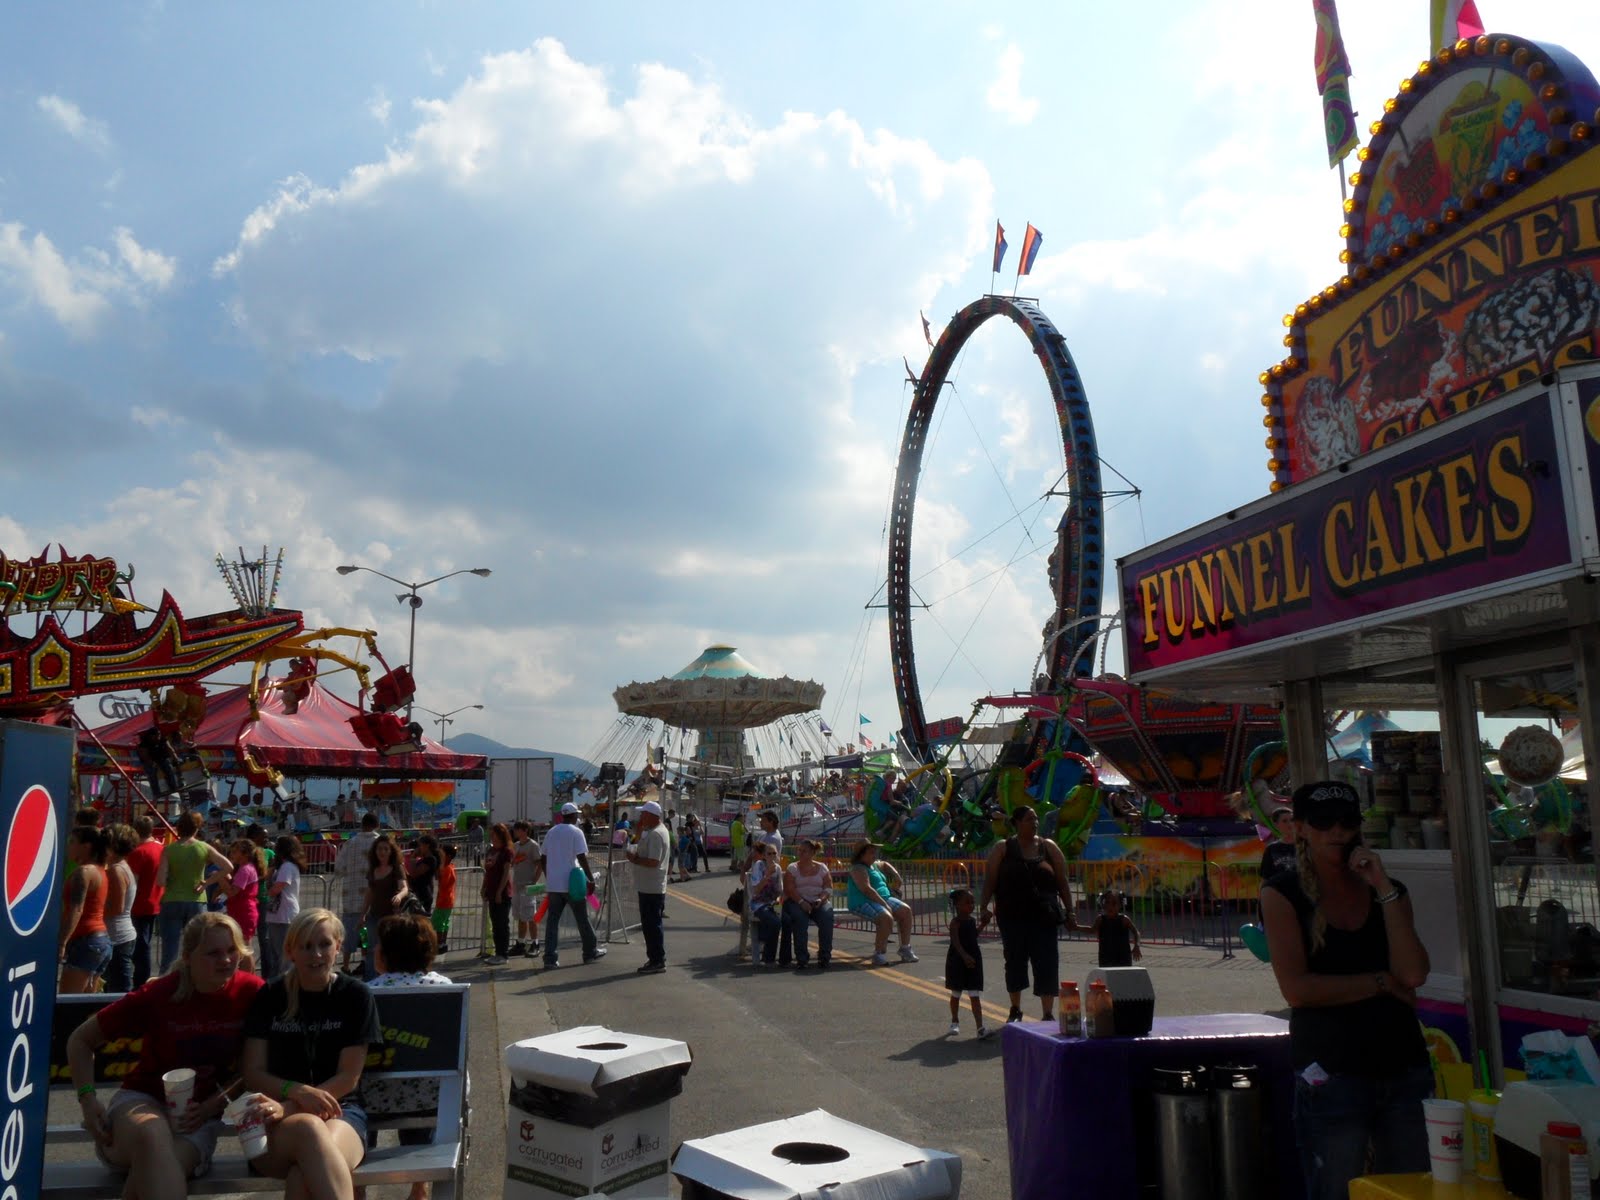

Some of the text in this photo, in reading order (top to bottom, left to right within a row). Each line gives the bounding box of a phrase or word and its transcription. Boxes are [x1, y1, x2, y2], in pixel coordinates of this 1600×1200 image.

[1139, 435, 1534, 645] FUNNEL CAKES
[0, 961, 37, 1200] epsi
[518, 1143, 583, 1170] corrugated
[600, 1136, 660, 1169] corrugated
